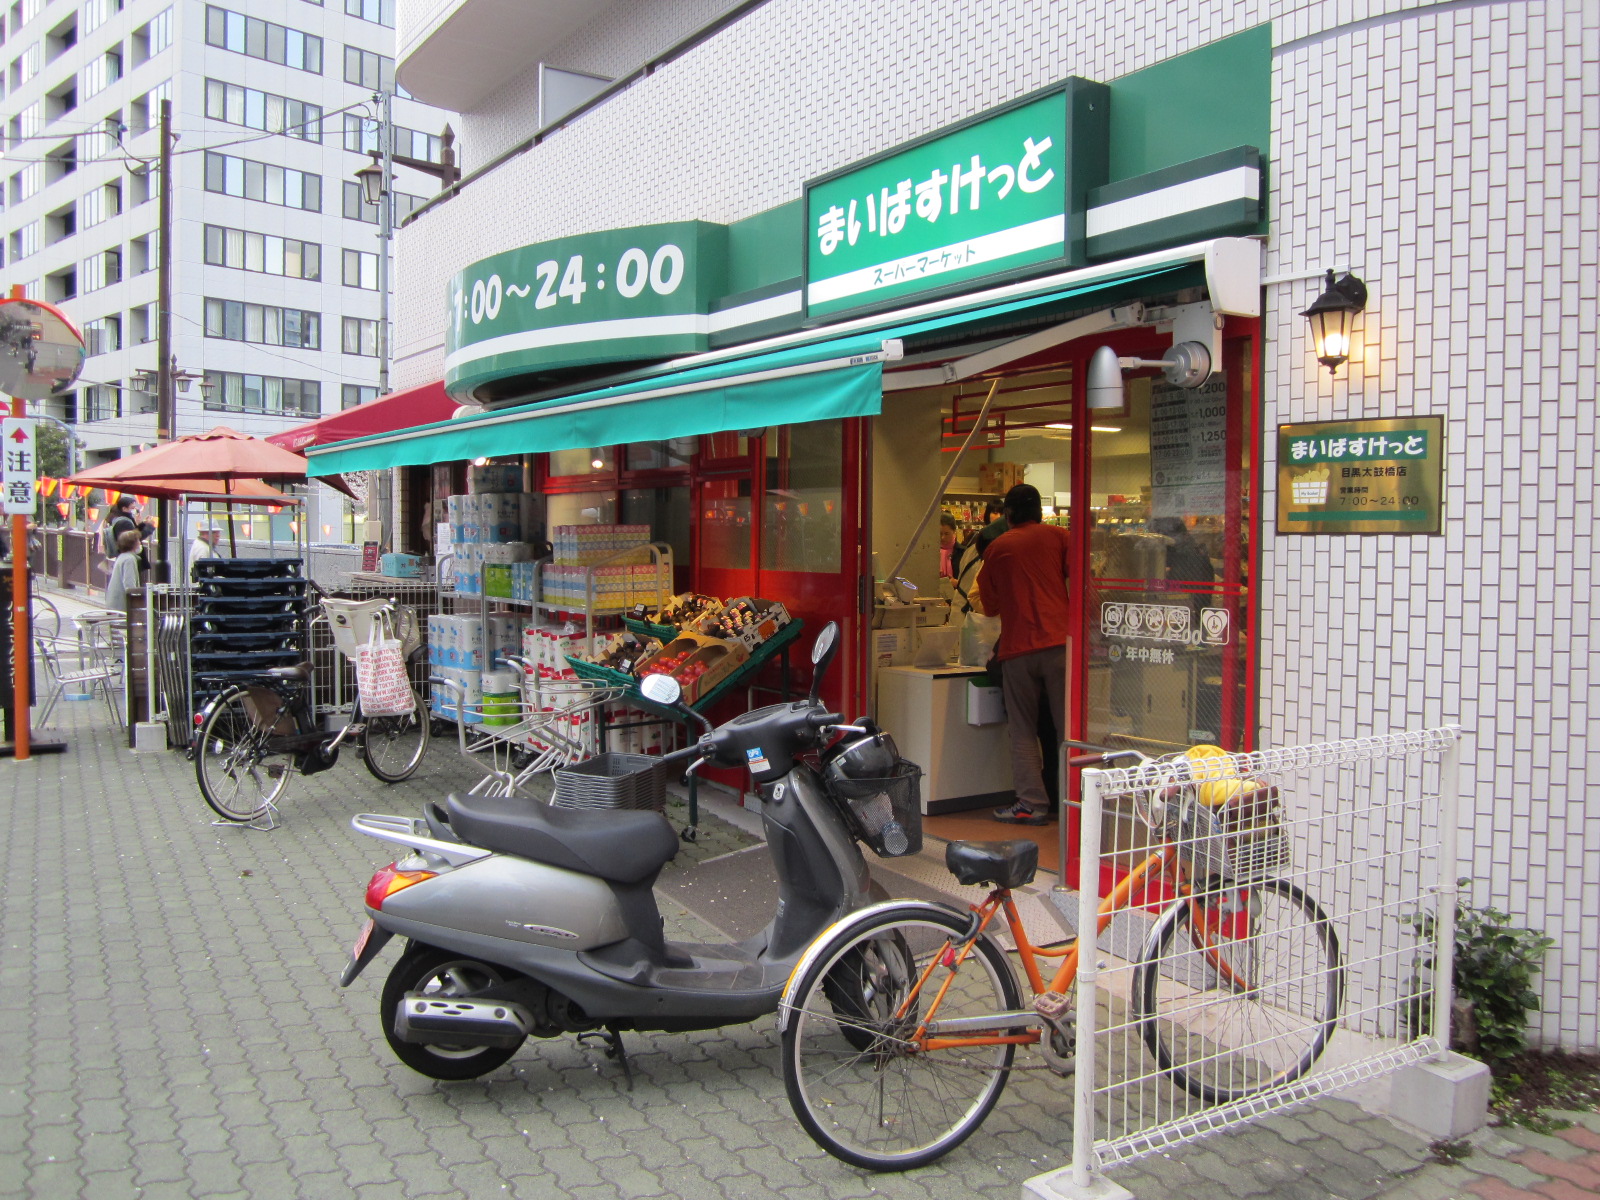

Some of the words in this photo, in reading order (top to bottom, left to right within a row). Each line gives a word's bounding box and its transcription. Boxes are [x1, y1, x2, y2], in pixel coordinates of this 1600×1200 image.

[817, 136, 1055, 255] まいばすけっと
[873, 244, 976, 286] スーパーマーケット
[1291, 435, 1424, 460] まいばすけっと
[7, 450, 32, 503] 注意
[1341, 466, 1407, 478] 目黒太鼓橋店
[1126, 646, 1175, 665] 年中無休
